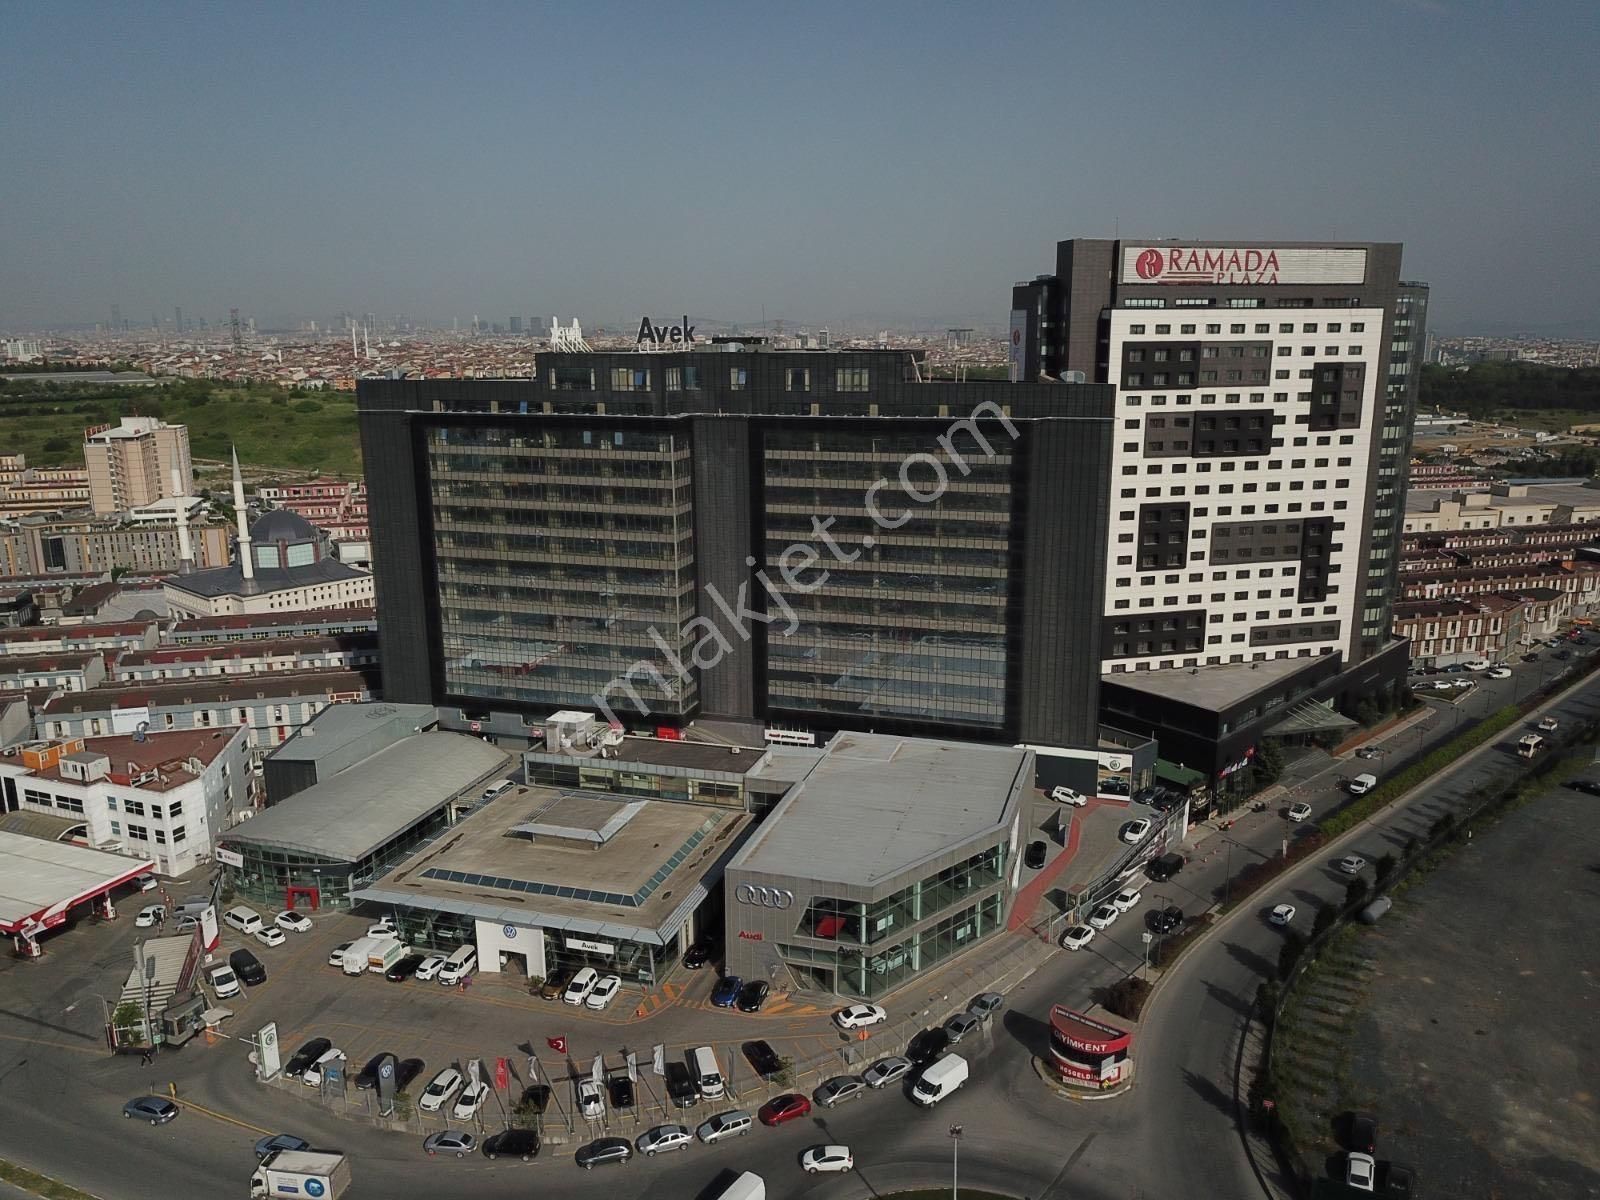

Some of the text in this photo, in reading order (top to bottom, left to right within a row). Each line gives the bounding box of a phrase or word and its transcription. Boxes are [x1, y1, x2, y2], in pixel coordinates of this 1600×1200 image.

[1168, 248, 1280, 272] RAMADA
[1216, 272, 1279, 284] PLAZA
[637, 315, 696, 344] Avek
[738, 930, 763, 941] Audi
